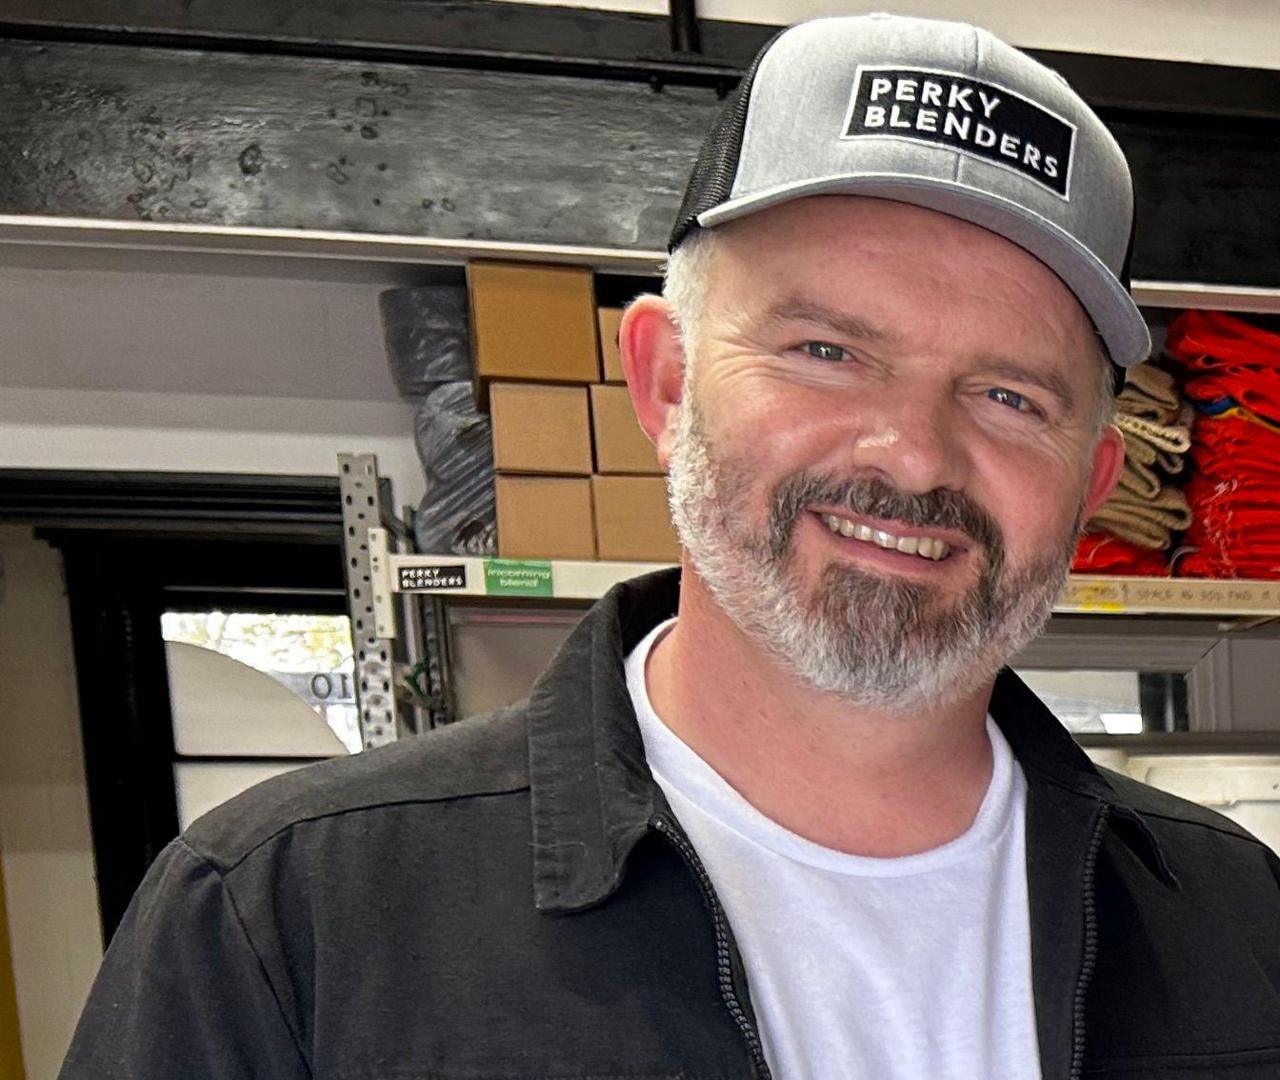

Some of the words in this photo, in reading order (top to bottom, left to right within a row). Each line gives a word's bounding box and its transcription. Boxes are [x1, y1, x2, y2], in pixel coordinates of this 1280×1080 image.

[870, 77, 1001, 118] PERKY
[864, 105, 1058, 178] BLENDERS
[401, 568, 440, 578] PERKY
[402, 576, 463, 588] BLENDERS
[500, 577, 539, 587] blend
